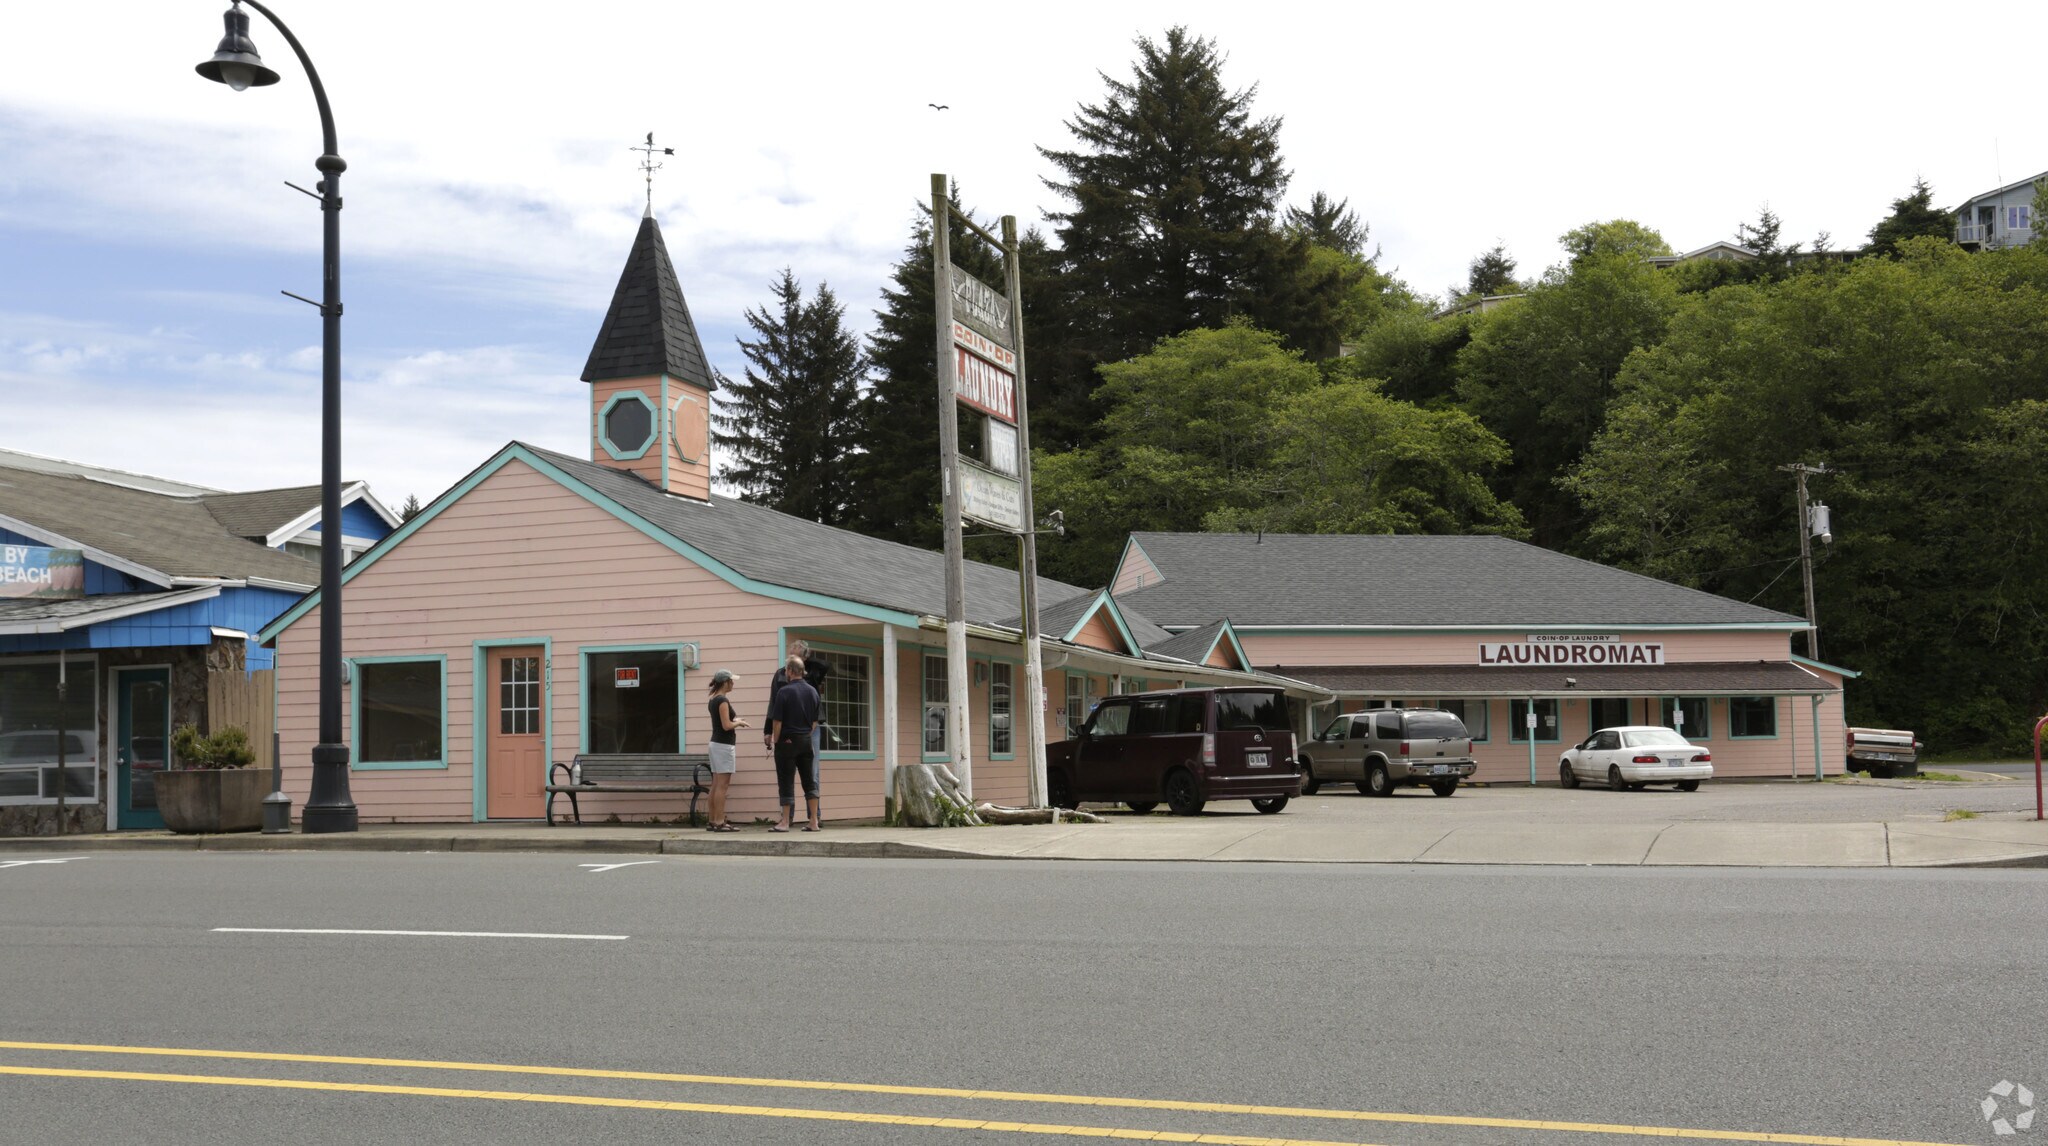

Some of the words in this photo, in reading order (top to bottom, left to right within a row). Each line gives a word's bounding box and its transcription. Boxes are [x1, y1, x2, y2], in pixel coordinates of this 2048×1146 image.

[954, 347, 1013, 419] LAUNDRY
[5, 546, 28, 564] BY
[1480, 644, 1661, 664] LAUNDROMAT
